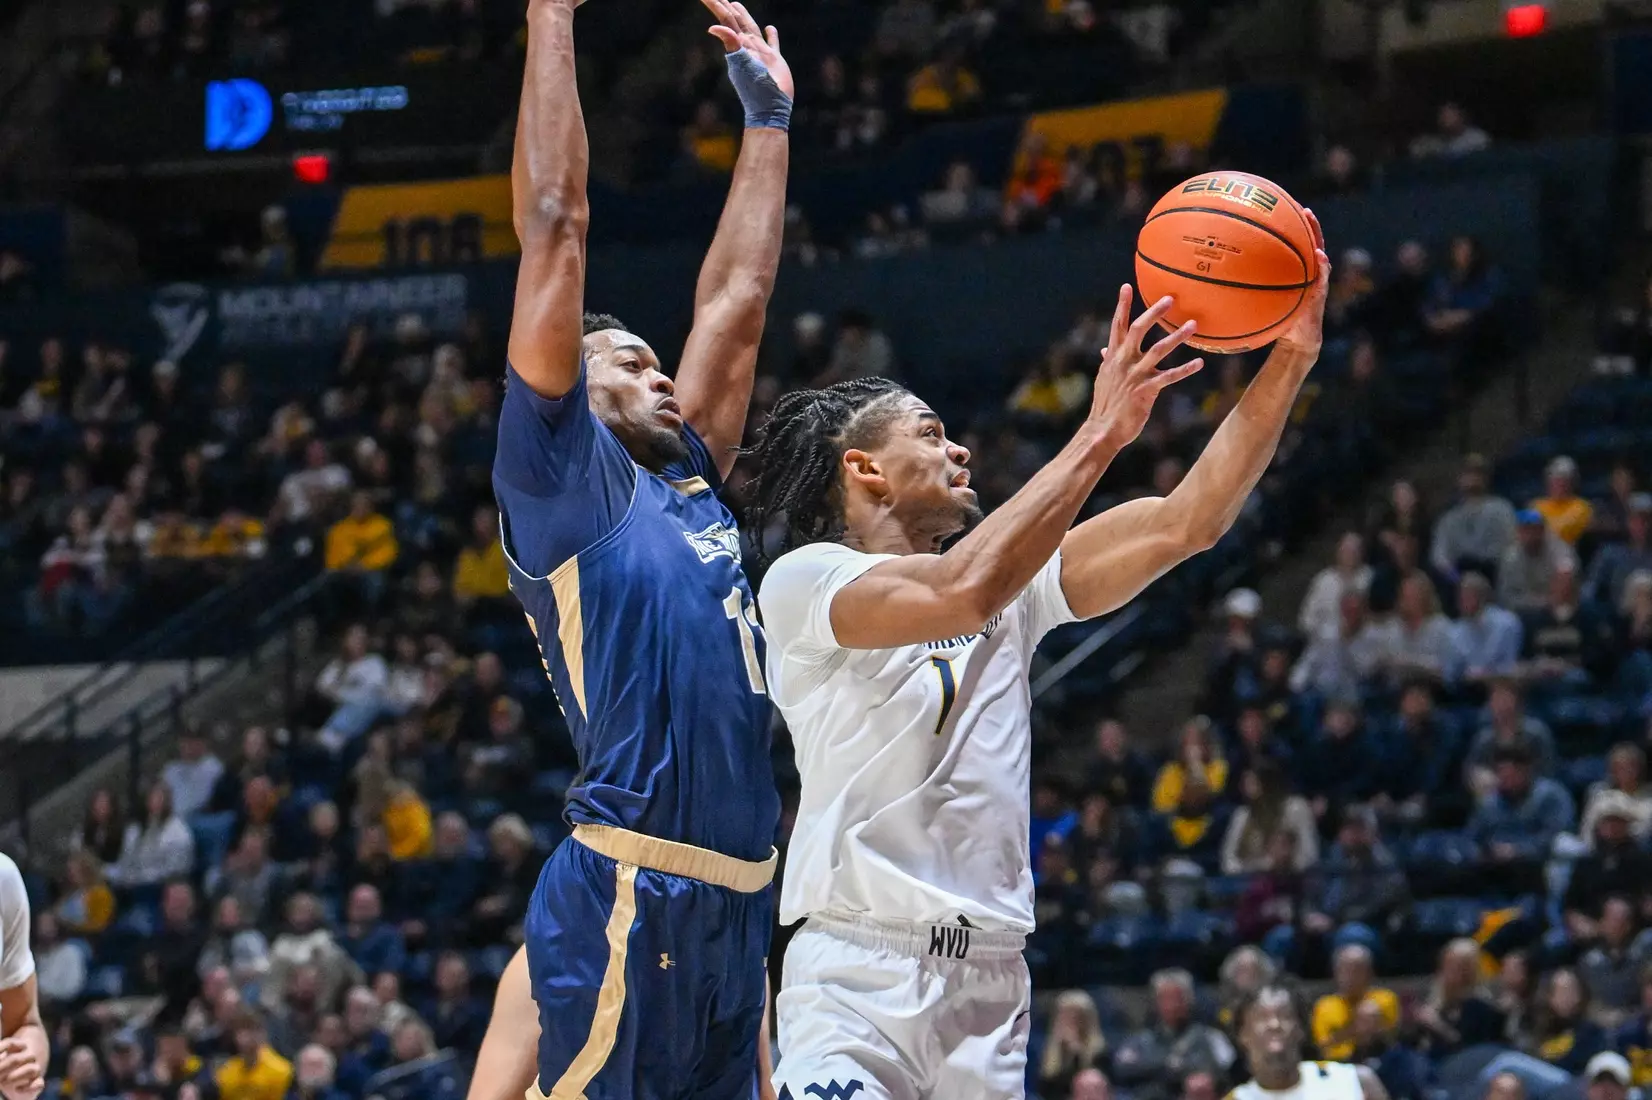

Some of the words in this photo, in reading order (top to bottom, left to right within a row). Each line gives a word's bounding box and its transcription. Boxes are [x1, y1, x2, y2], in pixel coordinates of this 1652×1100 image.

[1182, 178, 1278, 212] ELITE
[723, 586, 766, 694] 1
[931, 655, 957, 735] 1
[928, 925, 970, 960] WVU
